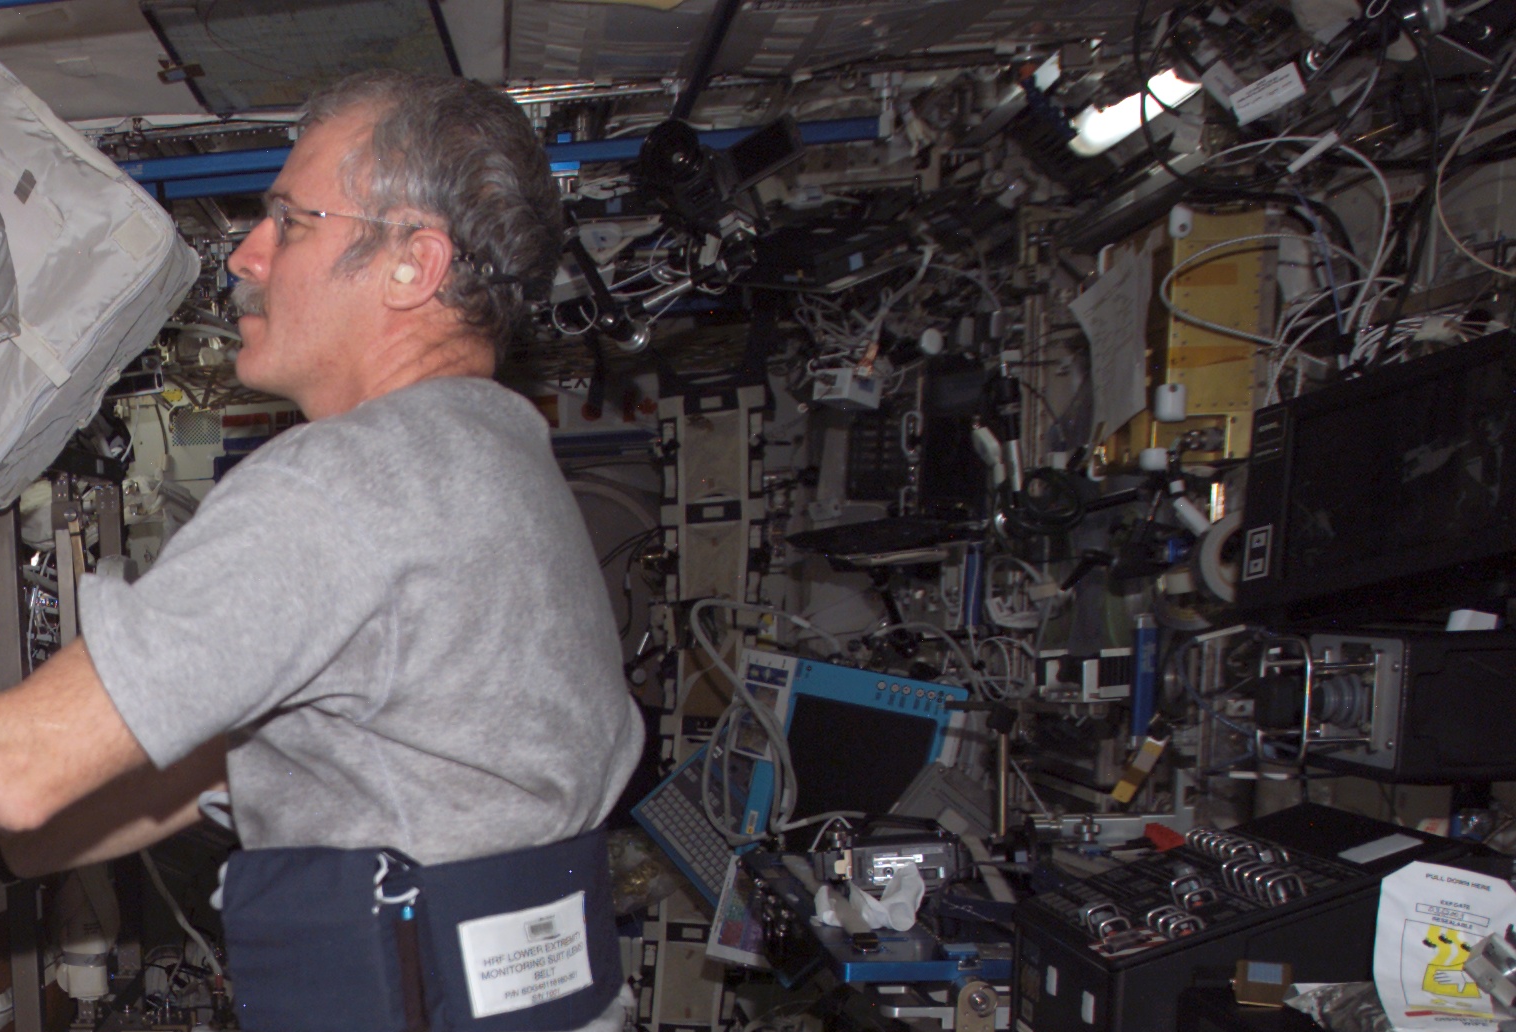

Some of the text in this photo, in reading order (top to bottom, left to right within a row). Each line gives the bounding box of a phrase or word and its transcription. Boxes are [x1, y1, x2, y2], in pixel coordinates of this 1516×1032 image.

[481, 957, 545, 981] MONITORING
[547, 950, 565, 965] SUIT
[483, 953, 506, 967] HRF
[507, 944, 544, 961] LOWER
[534, 966, 557, 981] BELT
